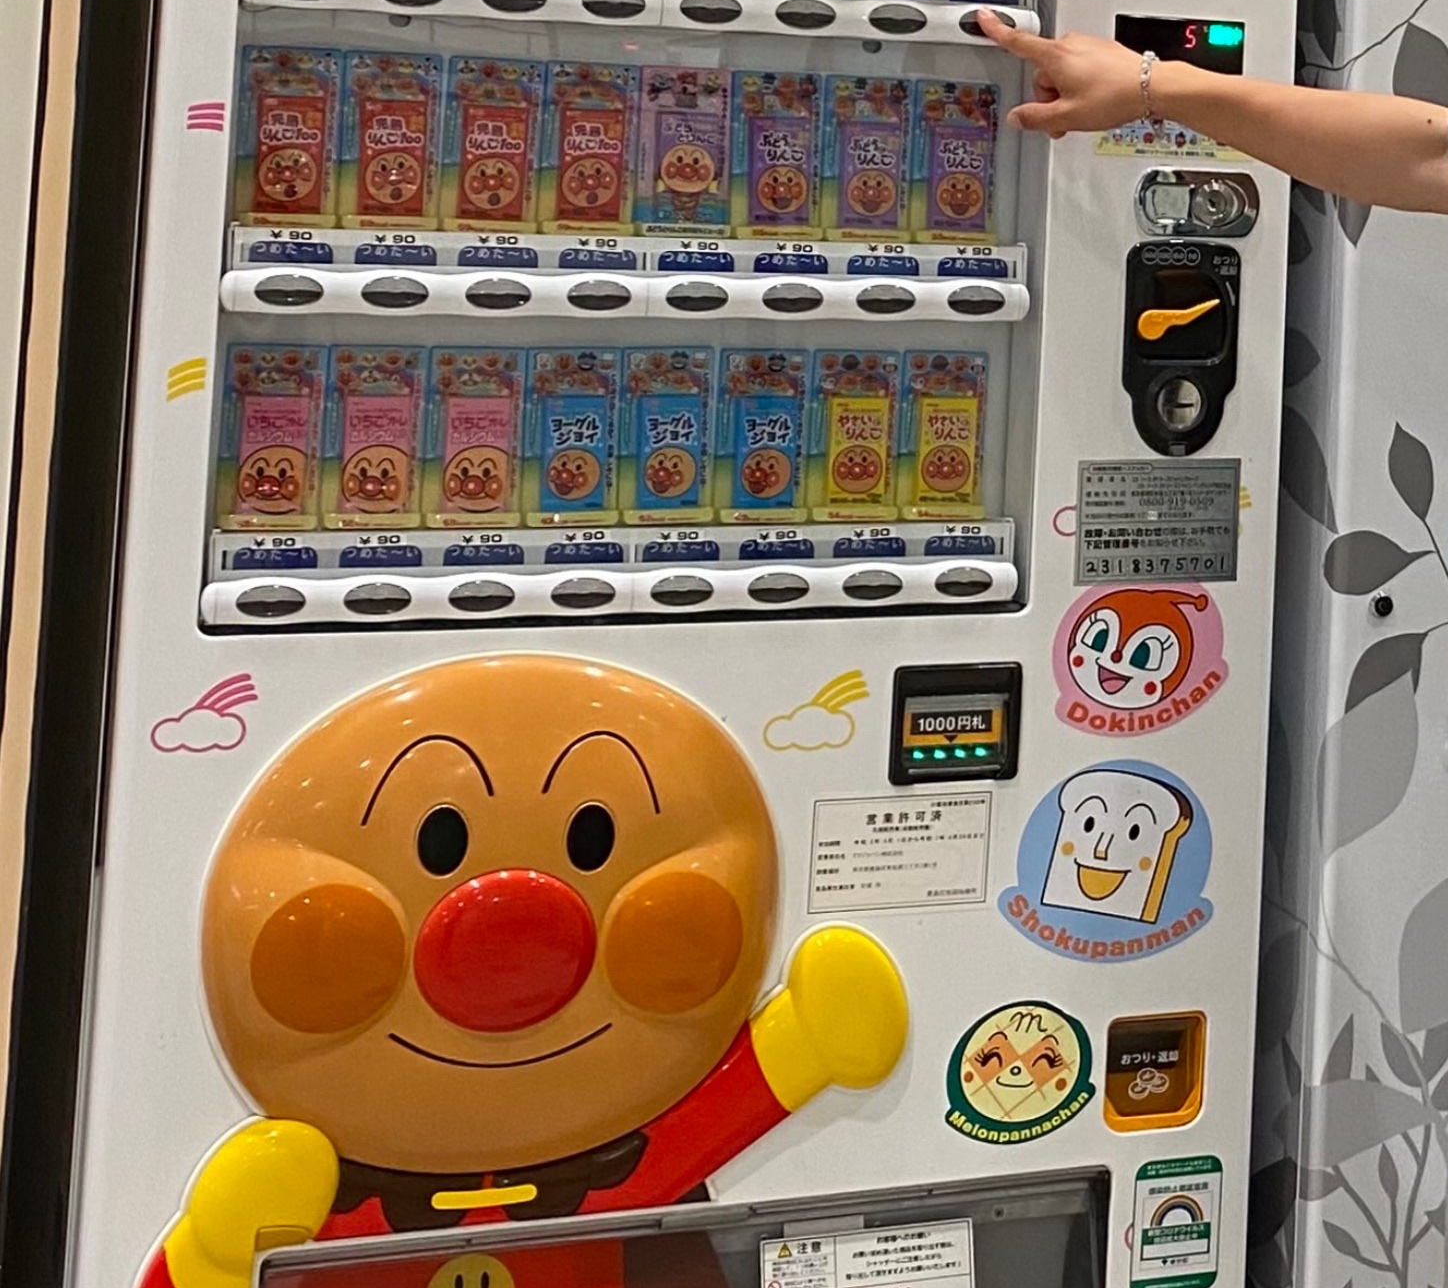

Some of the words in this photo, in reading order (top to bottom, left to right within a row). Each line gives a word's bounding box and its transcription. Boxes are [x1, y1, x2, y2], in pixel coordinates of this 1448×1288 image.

[767, 149, 804, 162] りんご
[857, 152, 894, 167] りんご
[944, 156, 983, 170] りんご
[845, 427, 883, 441] りんご
[933, 427, 970, 441] りんご
[1066, 670, 1221, 734] Dokinchan
[917, 715, 986, 732] 1000円札
[866, 810, 943, 825] 営業許可済
[1006, 894, 1205, 959] Shokupanman
[949, 1090, 1090, 1143] Melonpannachan
[796, 1241, 822, 1254] 注意
